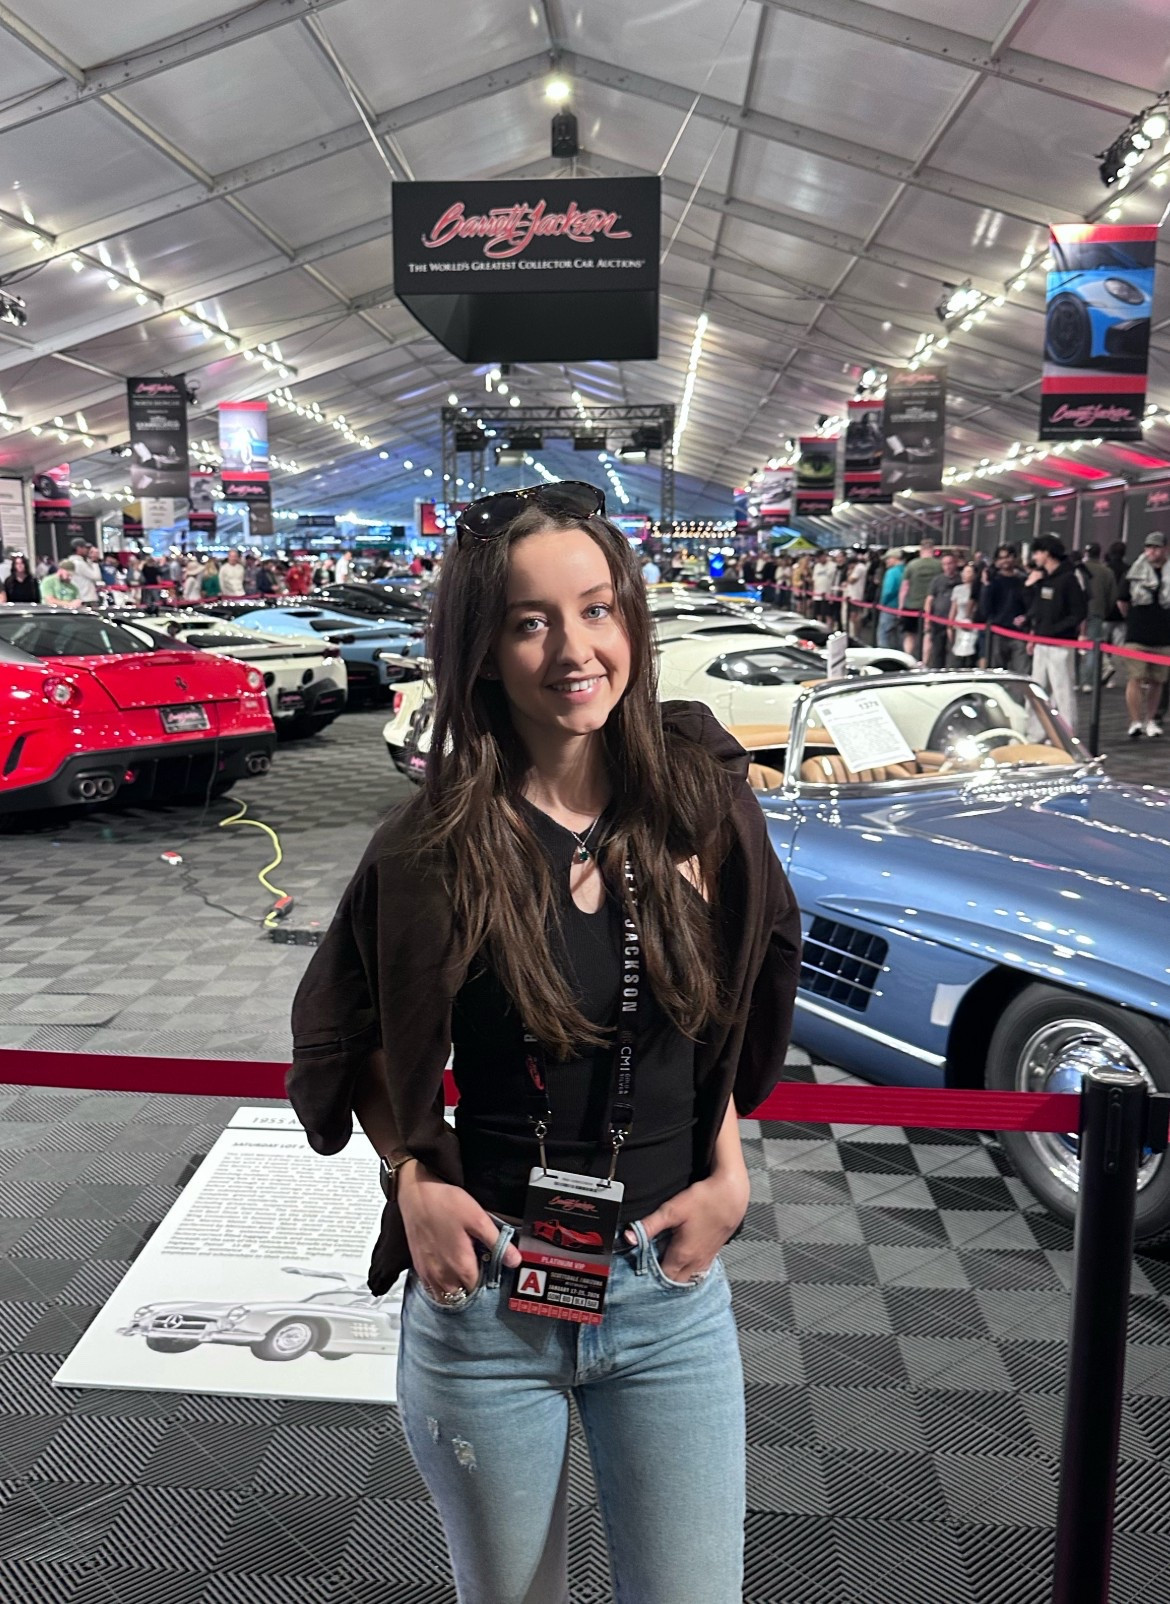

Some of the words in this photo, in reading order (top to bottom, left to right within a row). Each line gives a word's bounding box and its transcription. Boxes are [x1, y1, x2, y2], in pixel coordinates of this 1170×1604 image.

[408, 263, 427, 273] THE
[471, 261, 516, 271] GREATEST
[518, 260, 573, 270] COLLECTOR
[573, 259, 594, 269] CAR
[622, 919, 639, 1012] JACKSON
[619, 1046, 632, 1071] CMI
[520, 1270, 541, 1292] A
